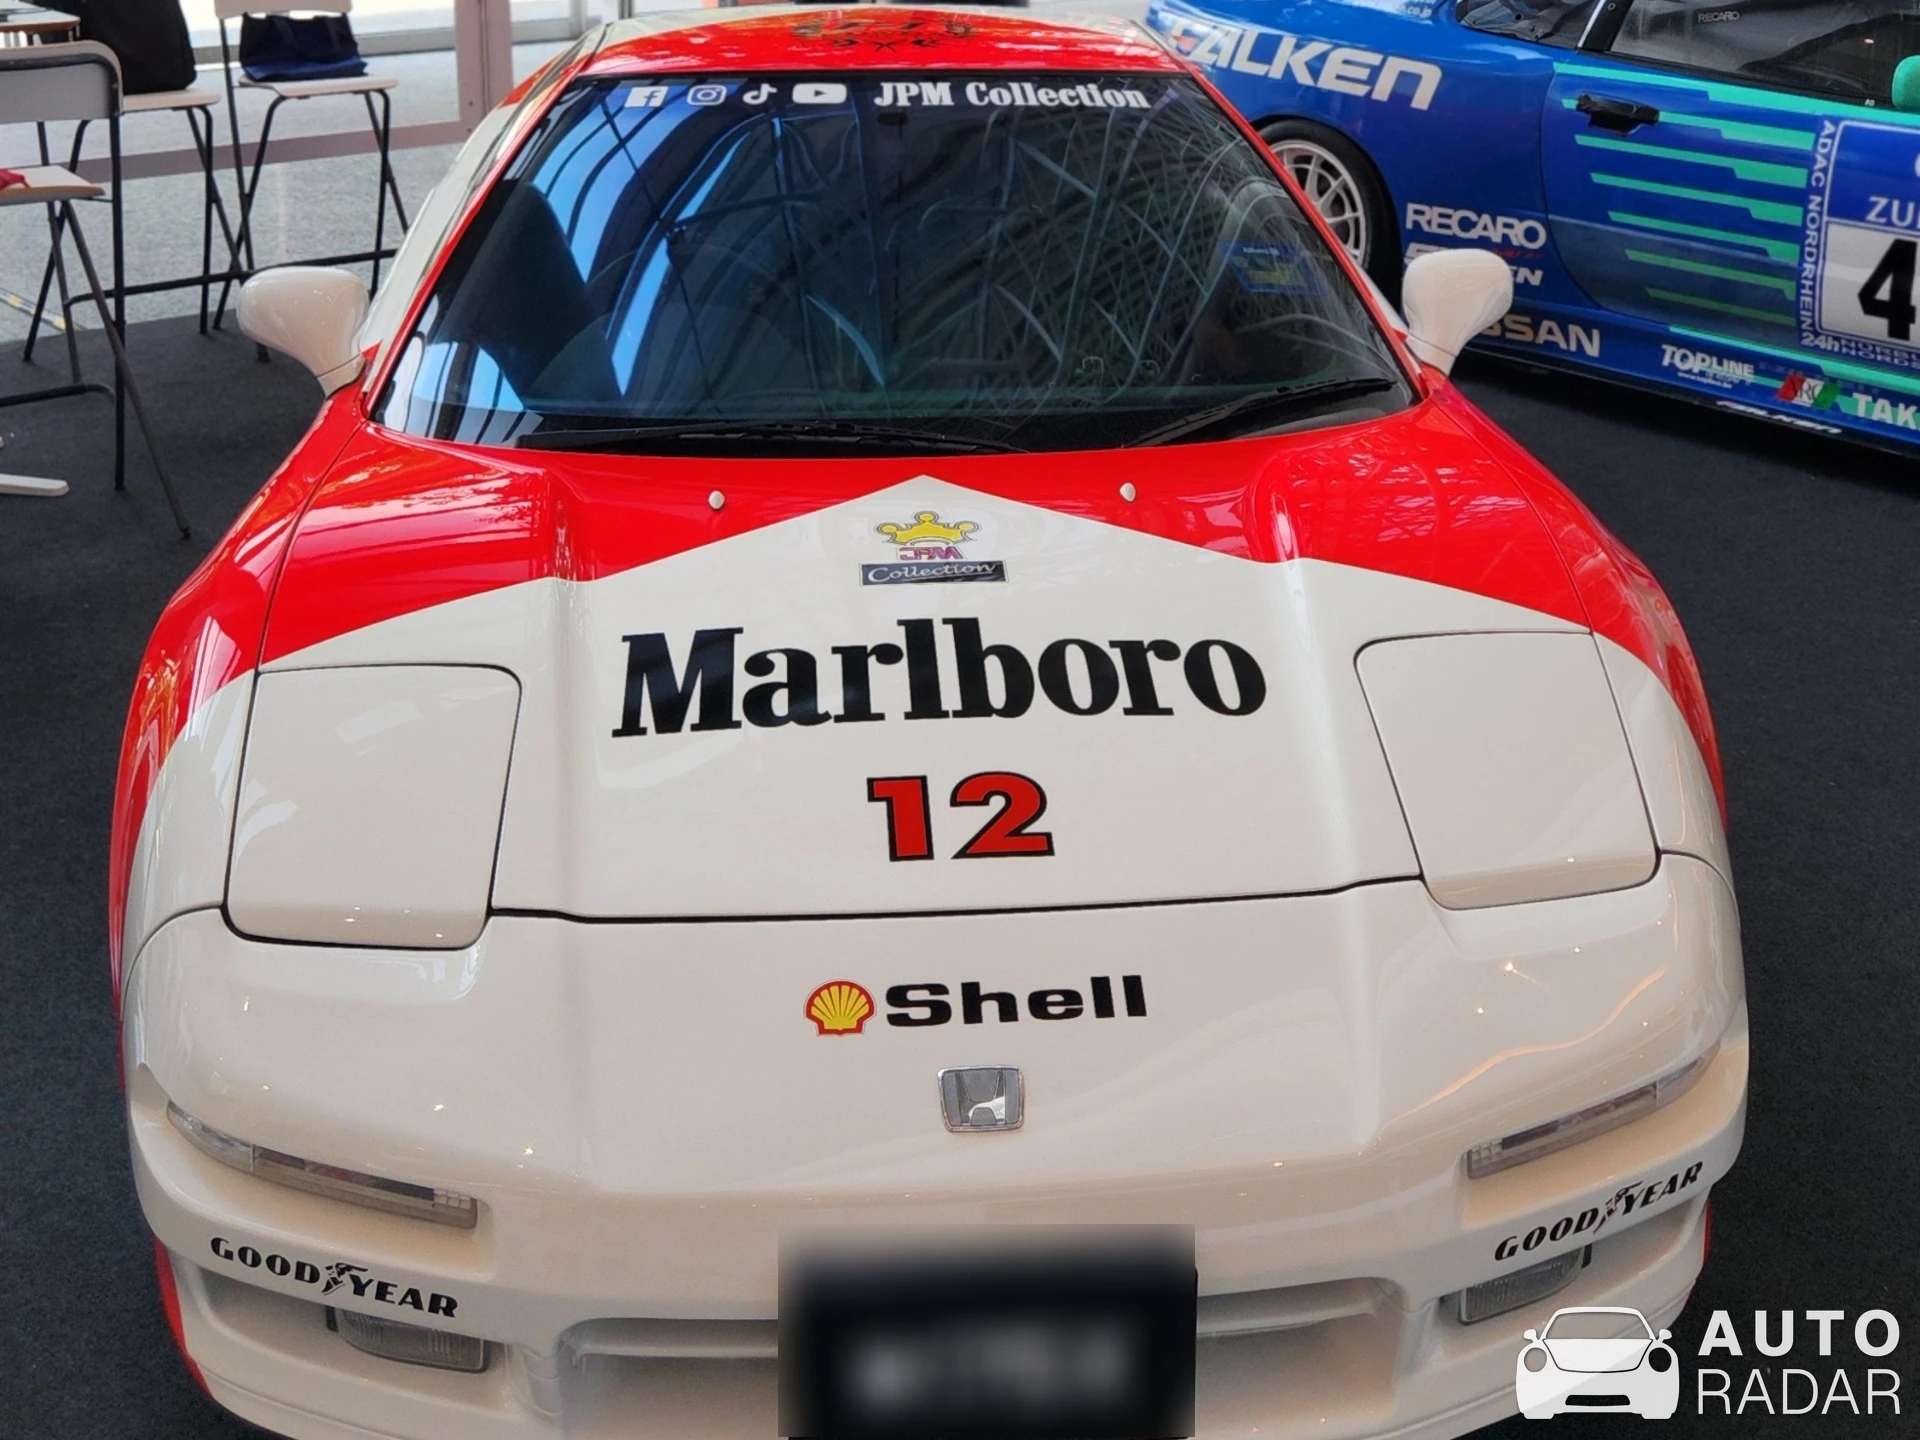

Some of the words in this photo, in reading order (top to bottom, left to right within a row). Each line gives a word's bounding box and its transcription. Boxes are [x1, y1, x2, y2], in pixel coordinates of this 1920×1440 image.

[1698, 11, 1740, 23] RECARO
[1168, 20, 1443, 111] FALKEN
[874, 82, 954, 106] JPM
[966, 82, 1152, 108] Collection
[1810, 119, 1836, 188] ADAC
[1405, 202, 1547, 249] RECARO
[1865, 195, 1920, 229] ZU
[1800, 195, 1823, 331] NORDRHEIN
[1661, 344, 1755, 378] TOPLINE
[1801, 331, 1840, 352] 24h
[1853, 392, 1920, 431] TAK
[868, 562, 997, 583] Collection
[898, 546, 964, 561] JPM
[612, 617, 1267, 737] Marlboro
[867, 771, 1055, 862] 12
[885, 975, 1147, 1027] Shell
